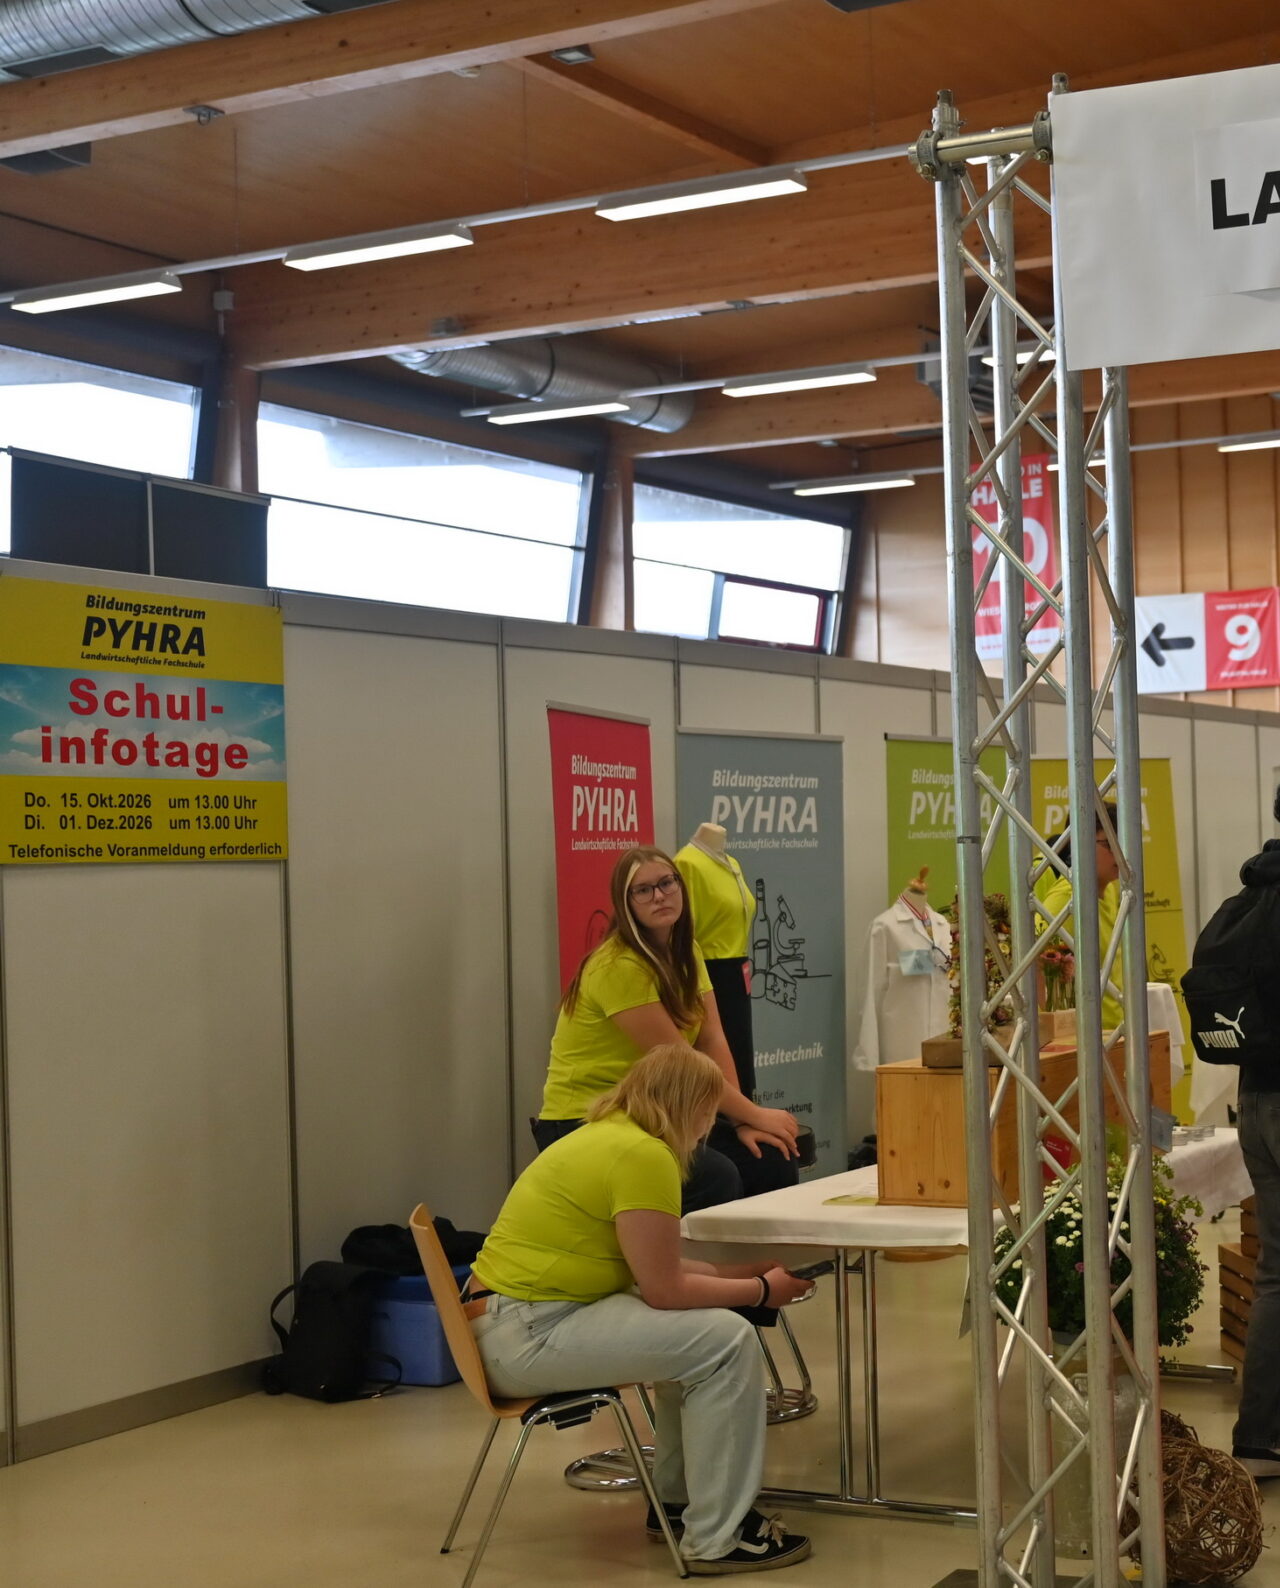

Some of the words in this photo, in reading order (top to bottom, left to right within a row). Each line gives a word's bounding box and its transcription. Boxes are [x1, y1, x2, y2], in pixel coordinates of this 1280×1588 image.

[972, 477, 1044, 507] HALE
[86, 594, 206, 620] Bildungszentrum
[82, 615, 206, 657] PYHRA
[1224, 614, 1261, 661] 9
[80, 651, 162, 666] Landwirtschaftliche
[163, 658, 206, 669] Fachschule
[68, 678, 224, 722] Schul-
[41, 725, 249, 778] infotage
[571, 754, 637, 783] Bildungszentrum
[712, 769, 819, 793] Bildungszentrum
[24, 792, 51, 808] Do.
[61, 793, 82, 808] 15.
[87, 793, 152, 809] Okt.2026
[168, 797, 190, 809] um
[195, 795, 229, 809] 13.00
[233, 795, 258, 809] Uhr
[572, 785, 639, 832] PYHRA
[711, 795, 818, 833] PYHRA
[909, 791, 993, 825] PYHA
[24, 814, 45, 830] Di.
[59, 815, 82, 830] 01.
[86, 814, 153, 830] Dez.2026
[169, 818, 191, 830] um
[195, 816, 230, 830] 13.00
[234, 815, 258, 830] Uhr
[8, 844, 103, 858] Telefonische
[107, 843, 206, 858] Voranmeldung
[209, 843, 282, 855] erforderlich
[725, 838, 780, 852] wirtschaftliche
[780, 837, 819, 849] Fachschule
[1197, 1029, 1240, 1049] PUMA
[753, 1042, 824, 1068] itteltechnik
